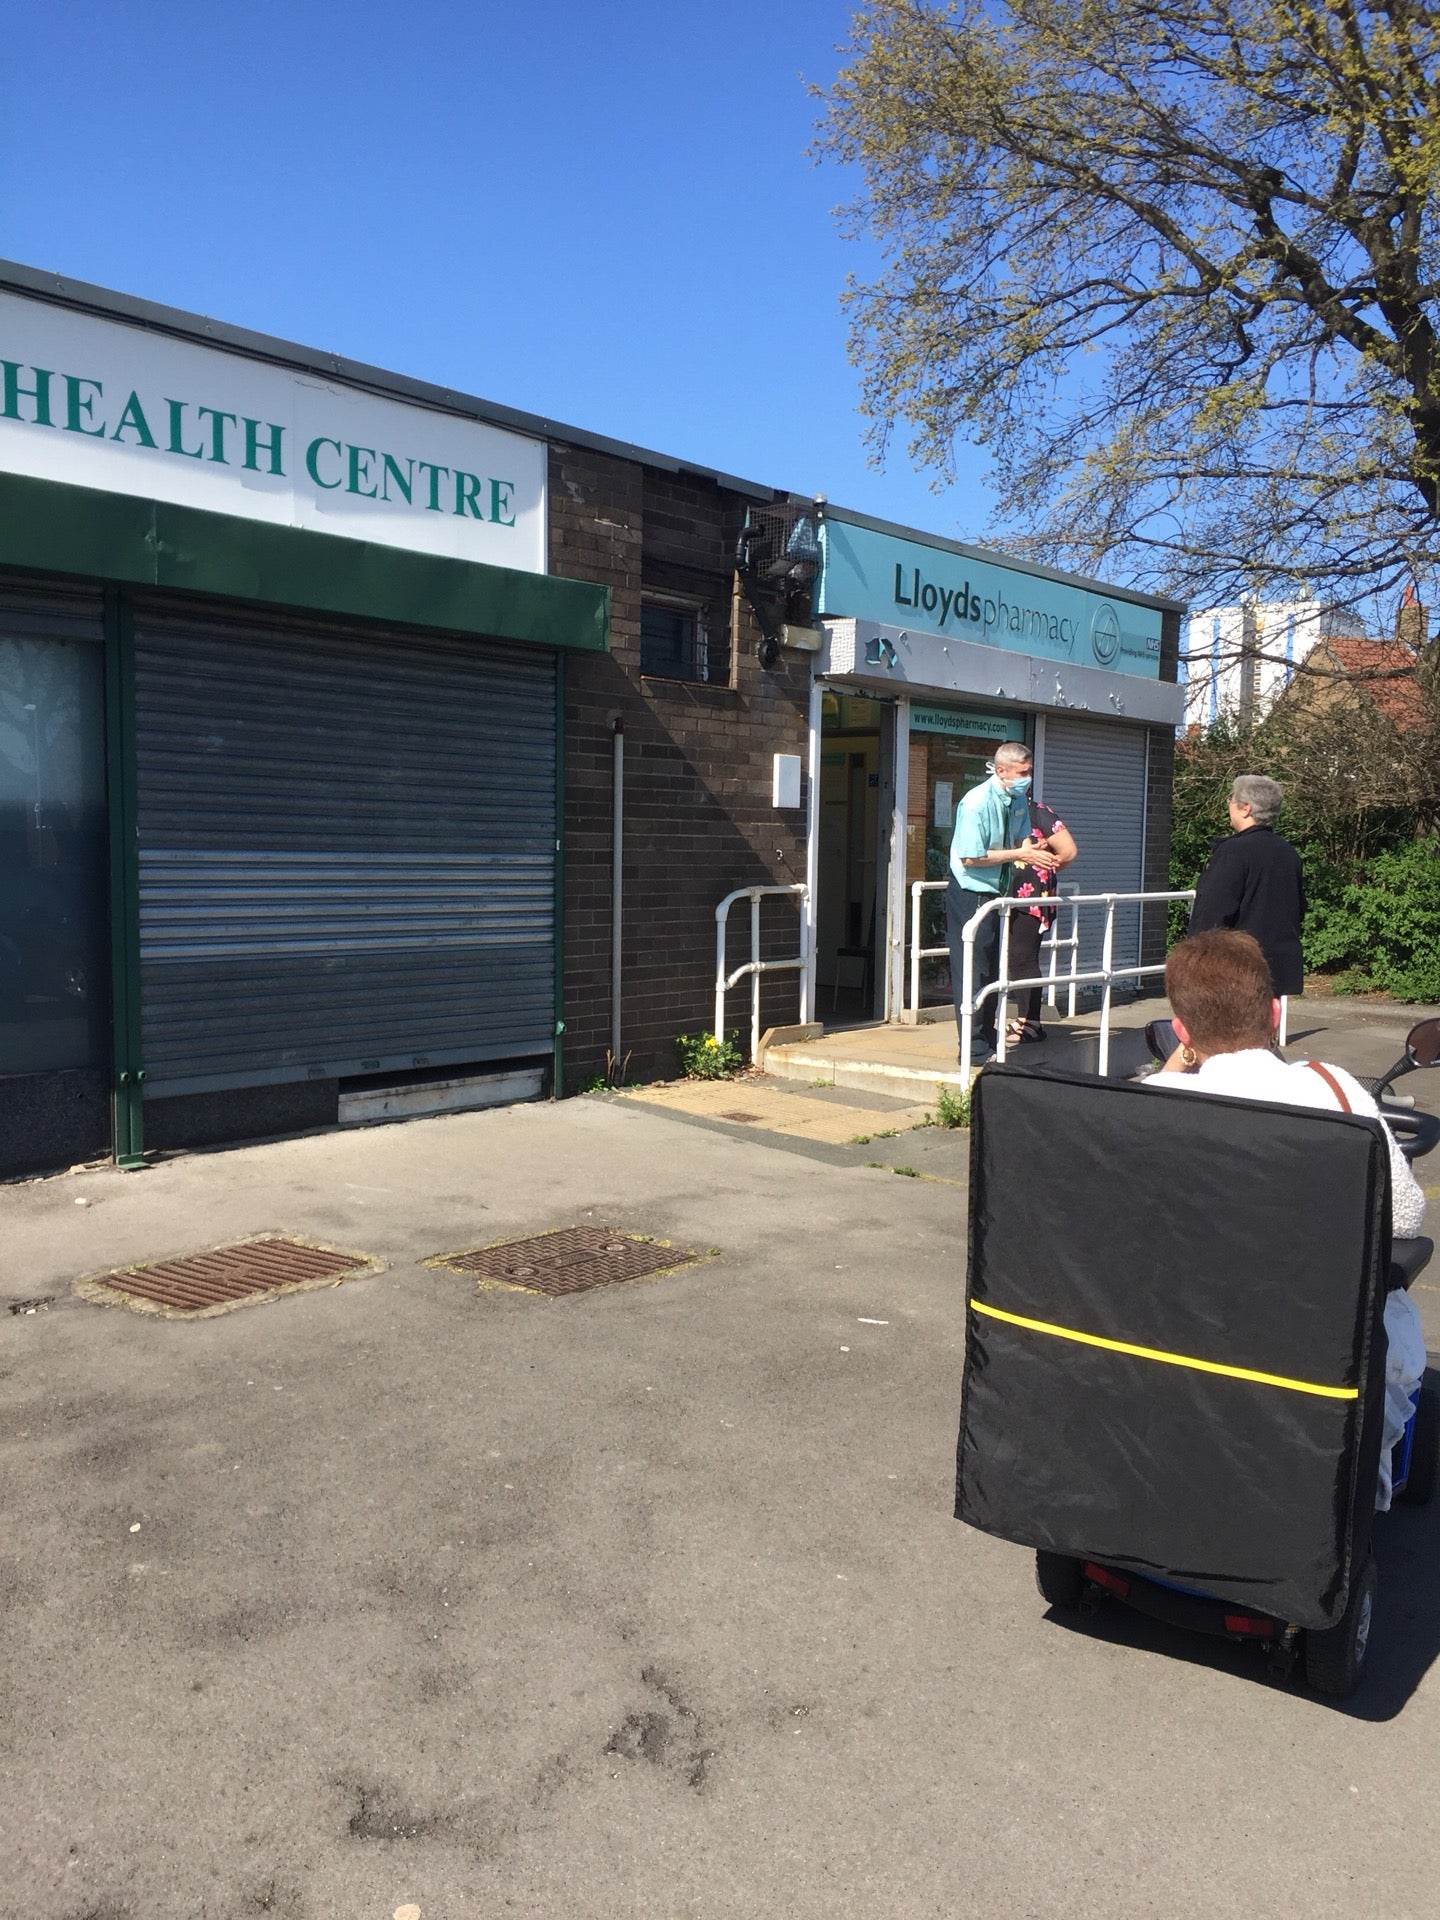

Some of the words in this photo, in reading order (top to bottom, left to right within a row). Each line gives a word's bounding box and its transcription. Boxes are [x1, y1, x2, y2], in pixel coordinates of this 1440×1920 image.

[0, 359, 287, 477] HEALTH
[305, 437, 517, 528] CENTRE
[894, 563, 1080, 656] Lloydspharmacy
[1147, 638, 1160, 651] NHS
[913, 712, 1007, 734] www.lloydspharmacy.com
